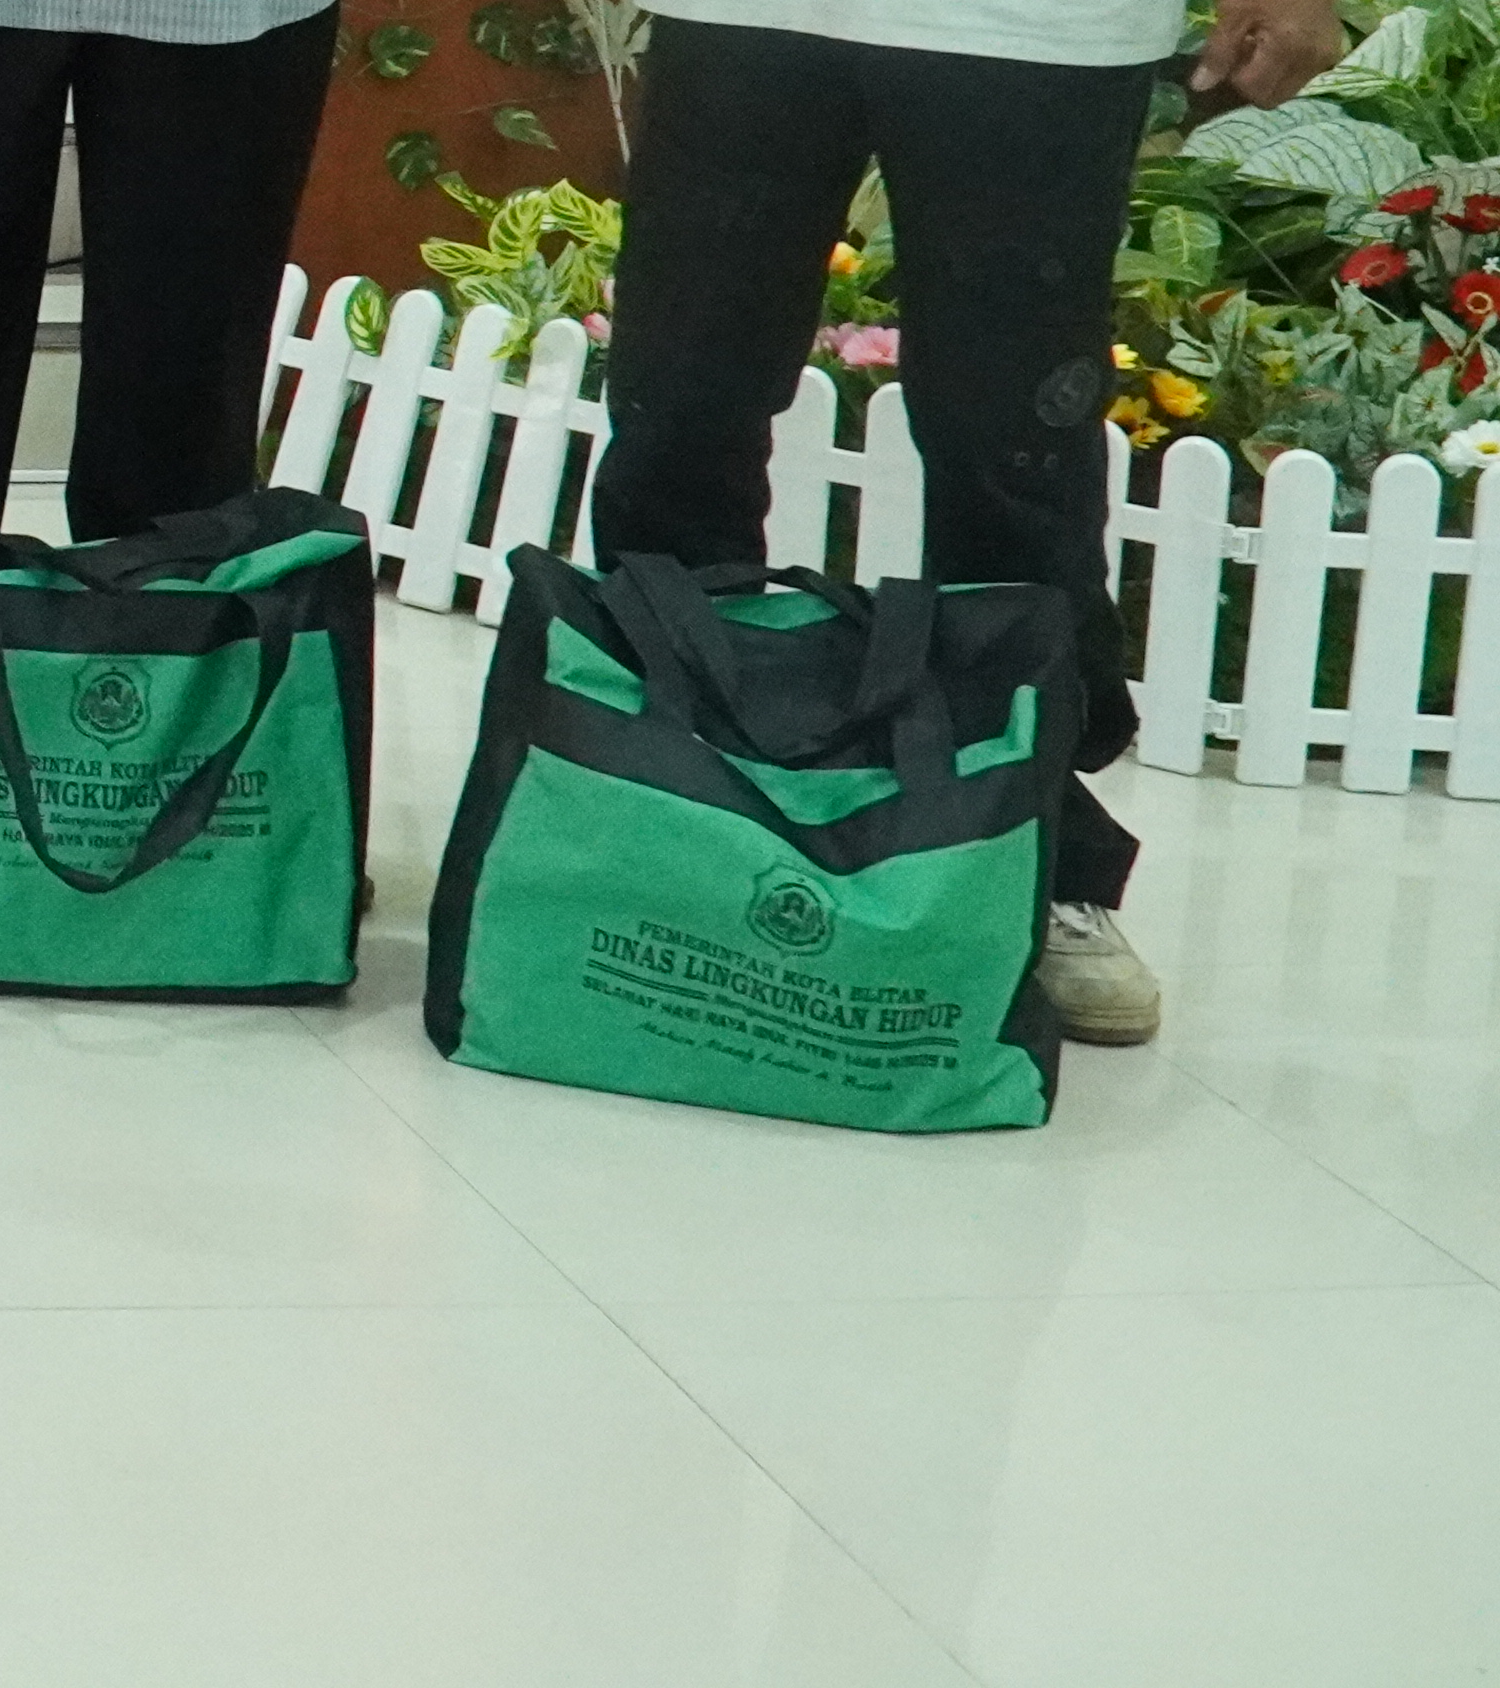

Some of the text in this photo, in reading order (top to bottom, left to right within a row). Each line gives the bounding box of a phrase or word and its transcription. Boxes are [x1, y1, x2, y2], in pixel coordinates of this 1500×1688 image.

[225, 770, 269, 798] DUP
[591, 927, 962, 1033] DINAS LINGKUNGAN HIDUP
[638, 920, 928, 1004] PEMERINTAH KOTA BLITAR
